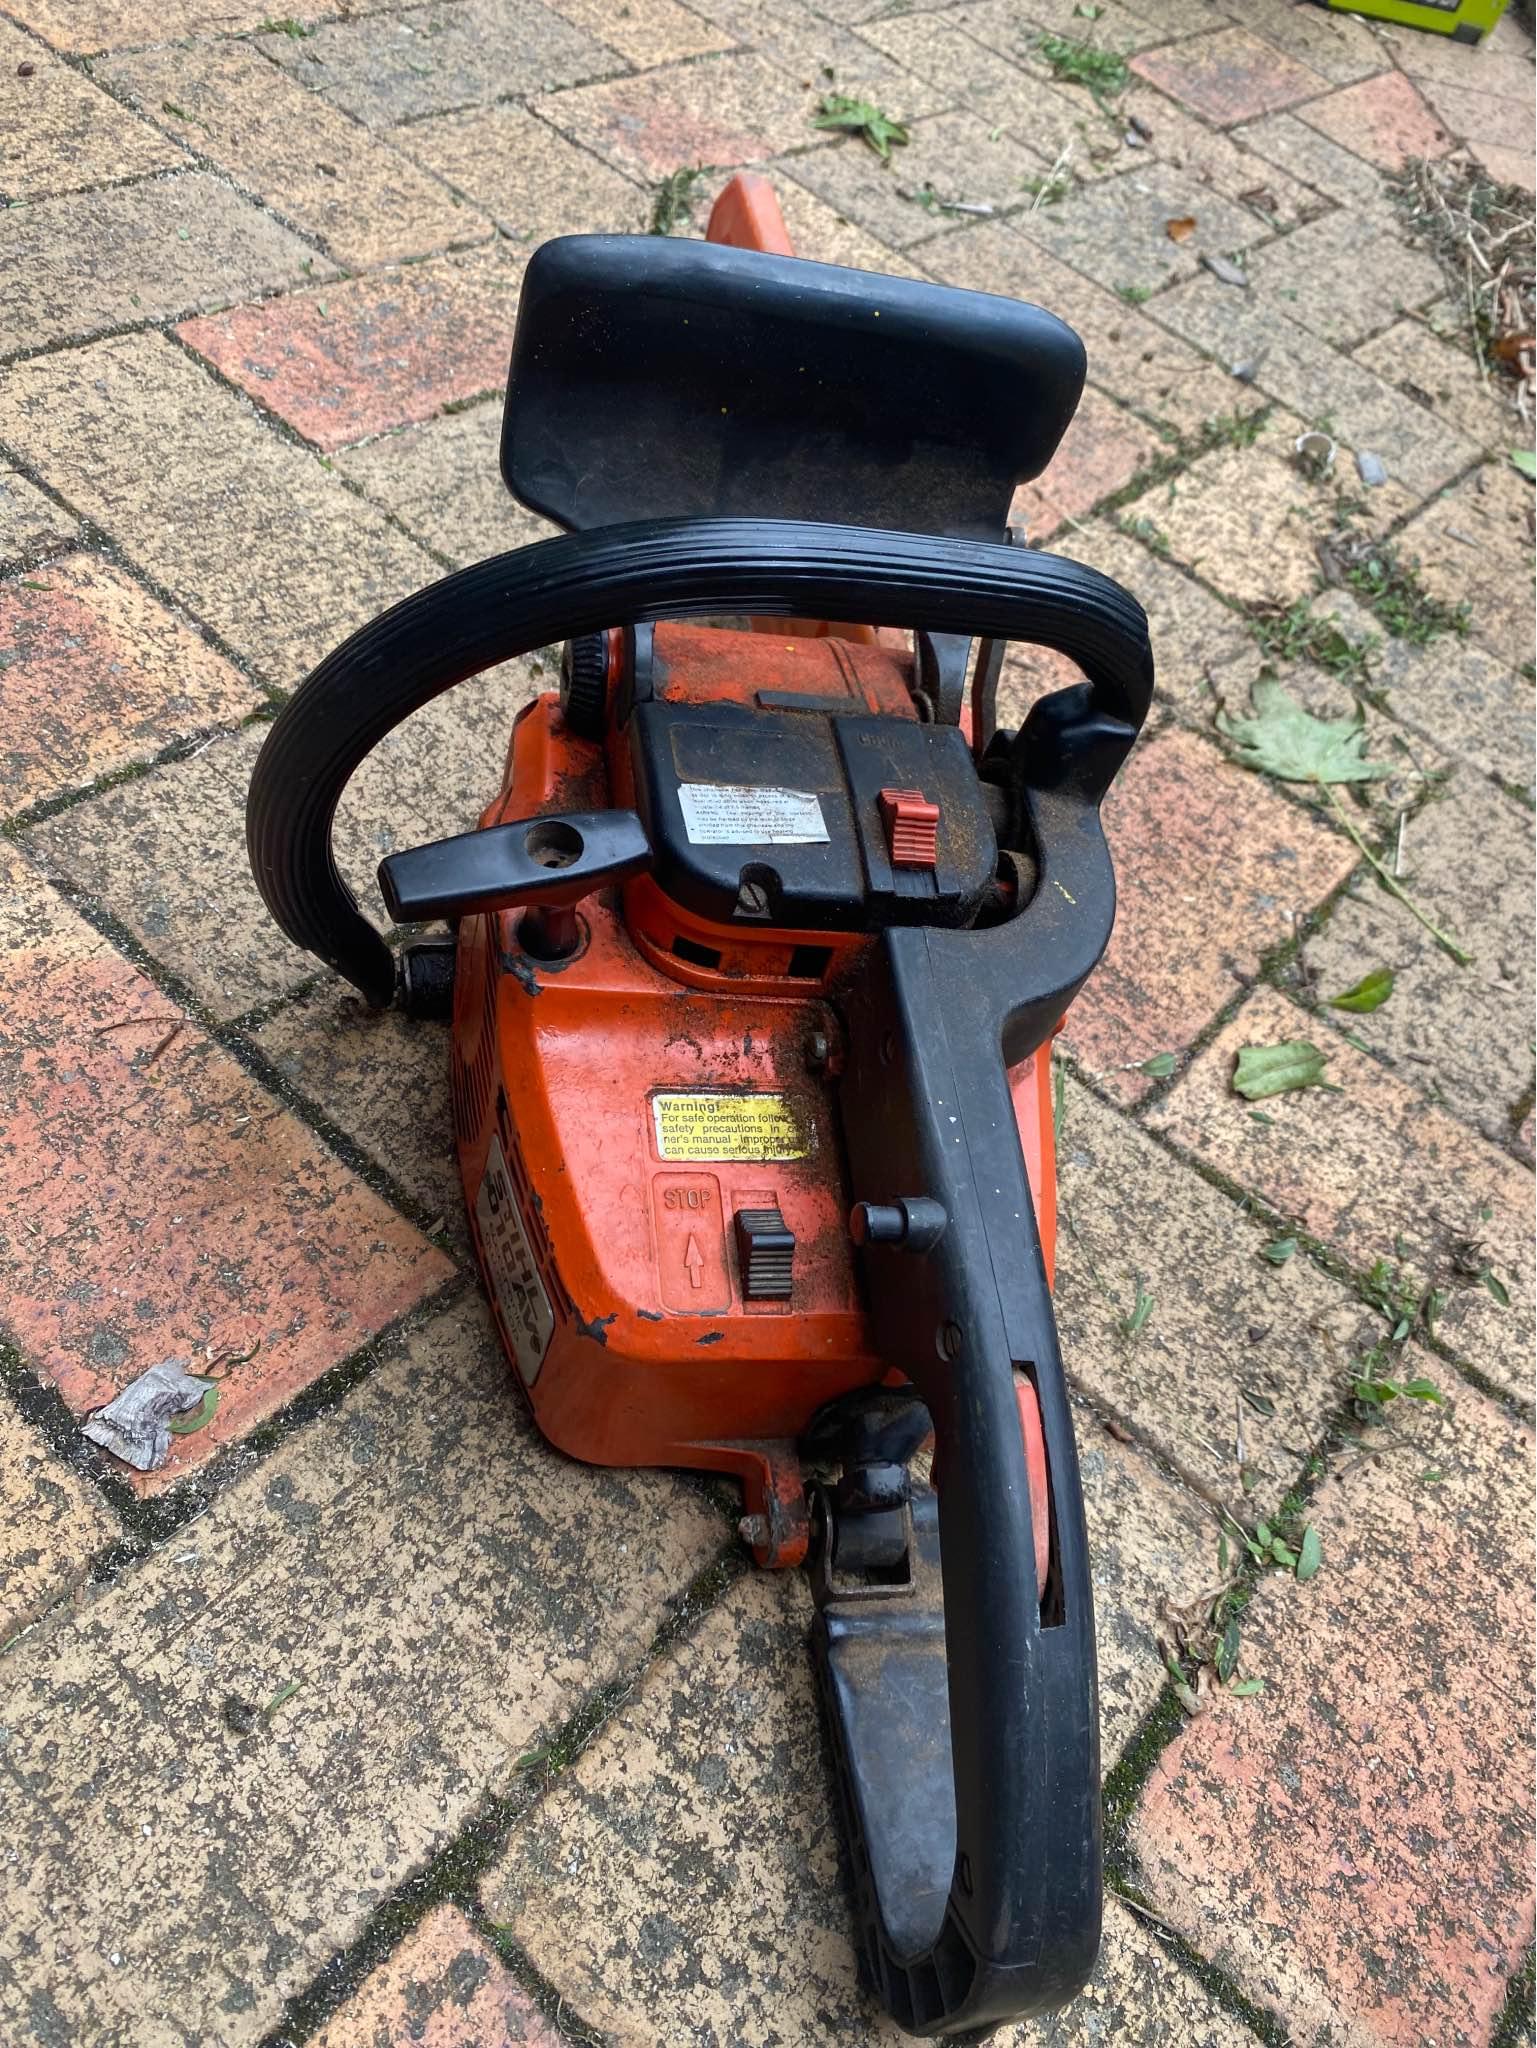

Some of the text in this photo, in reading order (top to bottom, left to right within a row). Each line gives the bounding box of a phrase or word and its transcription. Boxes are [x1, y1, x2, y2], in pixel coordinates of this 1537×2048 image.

[660, 1101, 721, 1113] Warning!
[661, 1114, 679, 1122] For
[682, 1114, 705, 1122] safe
[707, 1114, 756, 1124] operation
[662, 1124, 694, 1135] safety
[702, 1124, 763, 1135] precautions
[770, 1124, 780, 1133] in
[663, 1135, 690, 1144] ner's
[692, 1135, 731, 1144] manual
[664, 1146, 684, 1155] can
[687, 1146, 719, 1155] cause
[722, 1145, 760, 1155] serious
[664, 1188, 711, 1210] STOP
[493, 1168, 539, 1322] STIHL
